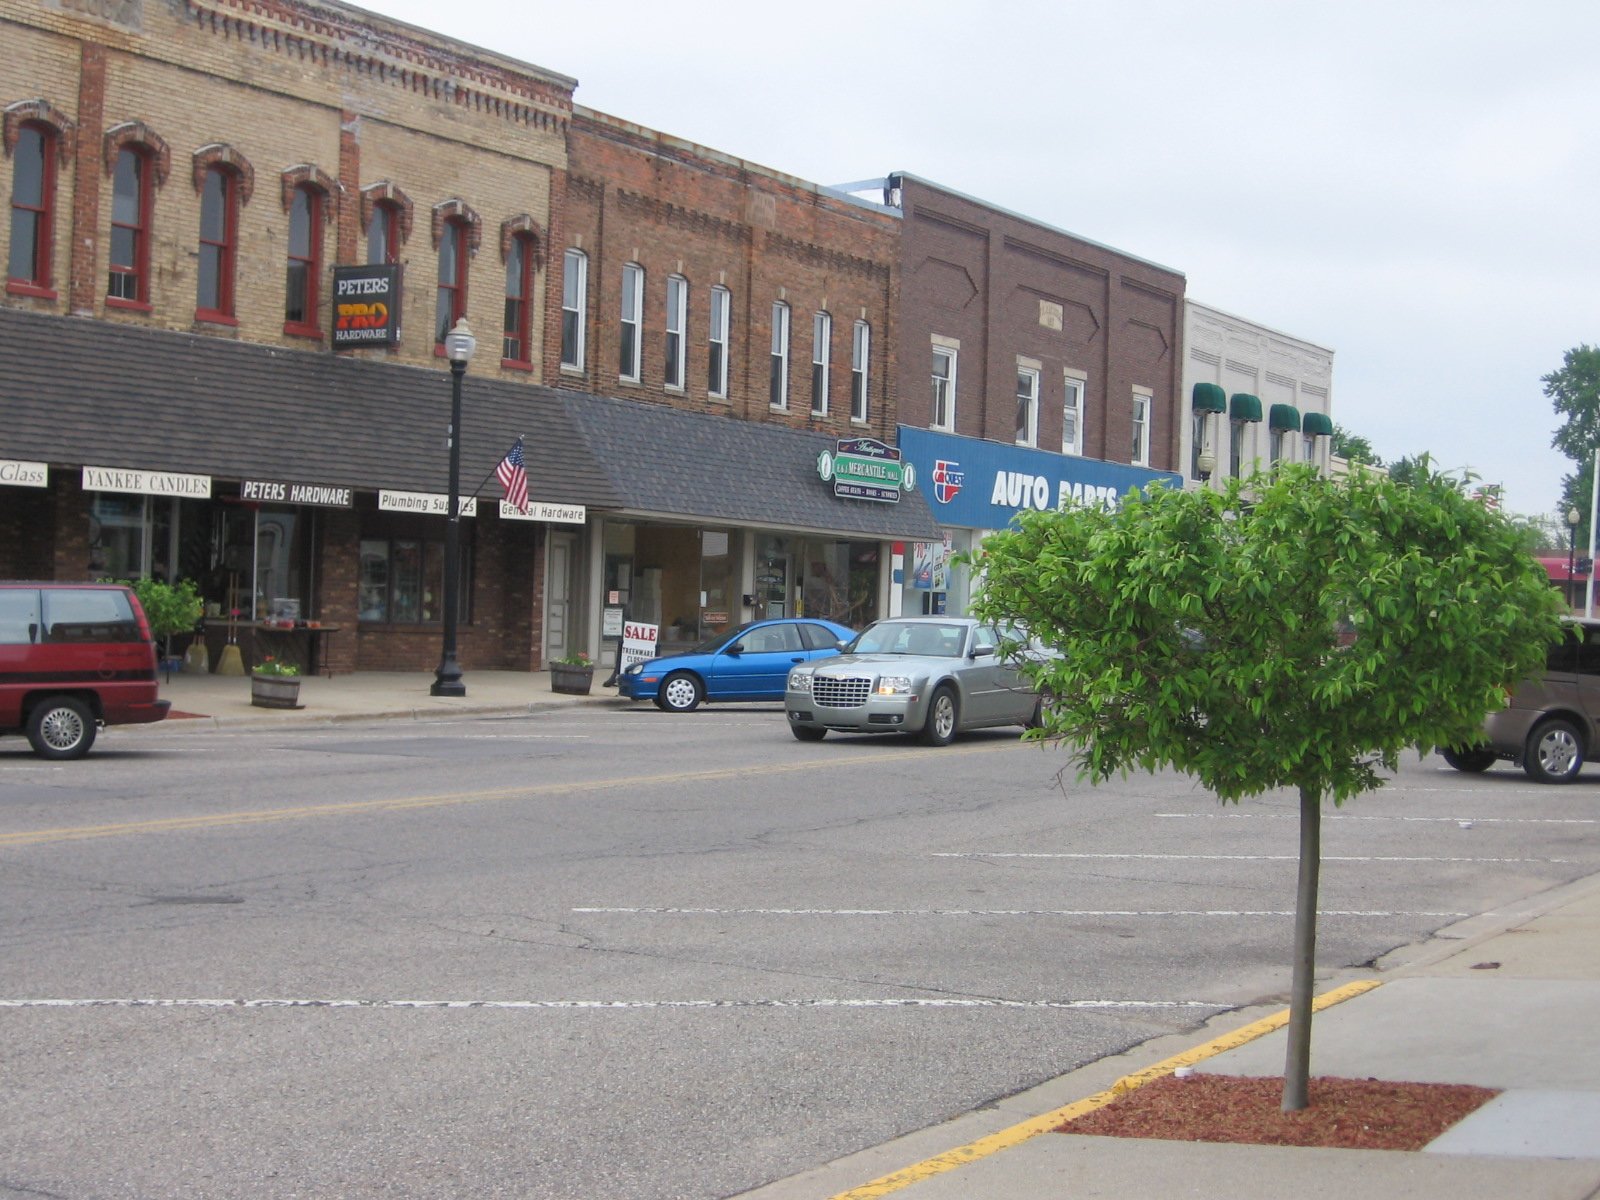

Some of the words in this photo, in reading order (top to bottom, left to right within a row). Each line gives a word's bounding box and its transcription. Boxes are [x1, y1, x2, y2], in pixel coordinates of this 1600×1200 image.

[338, 278, 389, 295] PETERS
[336, 303, 388, 329] PRO
[336, 329, 387, 340] HARDWARE
[0, 464, 44, 482] Glass
[849, 461, 886, 478] MERCANTILE
[88, 470, 142, 489] YANKEE
[150, 475, 208, 494] CANDLES
[243, 481, 286, 500] PETERS
[290, 485, 351, 505] HARDWARE
[991, 471, 1049, 511] AUTO
[1058, 480, 1117, 515] PARTS
[382, 495, 428, 511] Plumbing
[433, 498, 474, 512] Supies
[502, 504, 537, 517] Genal
[541, 507, 584, 520] Hardware
[625, 625, 656, 641] SALE
